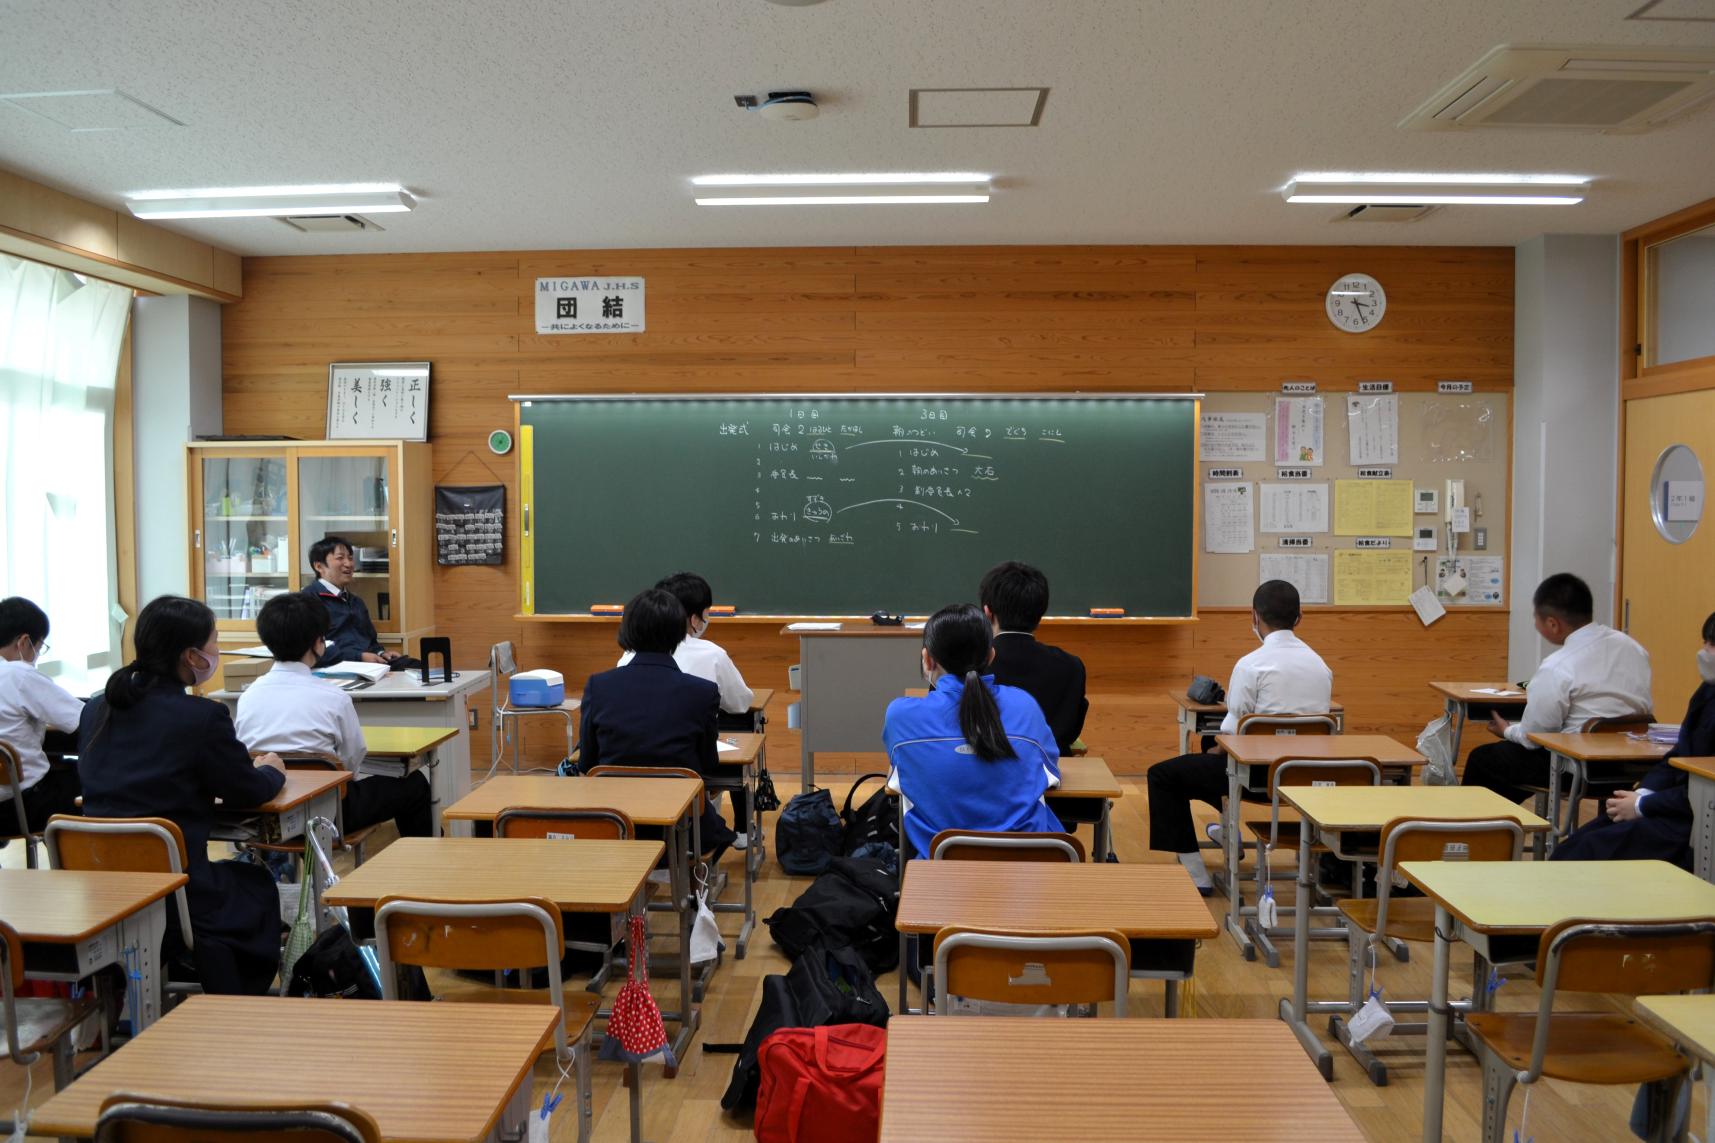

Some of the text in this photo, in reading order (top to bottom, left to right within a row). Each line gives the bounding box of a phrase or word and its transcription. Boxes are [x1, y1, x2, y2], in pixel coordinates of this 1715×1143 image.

[540, 281, 639, 292] MIGAWA J.H.S
[351, 377, 363, 425] 美しく
[380, 378, 392, 407] 強く
[408, 378, 421, 425] 正しく
